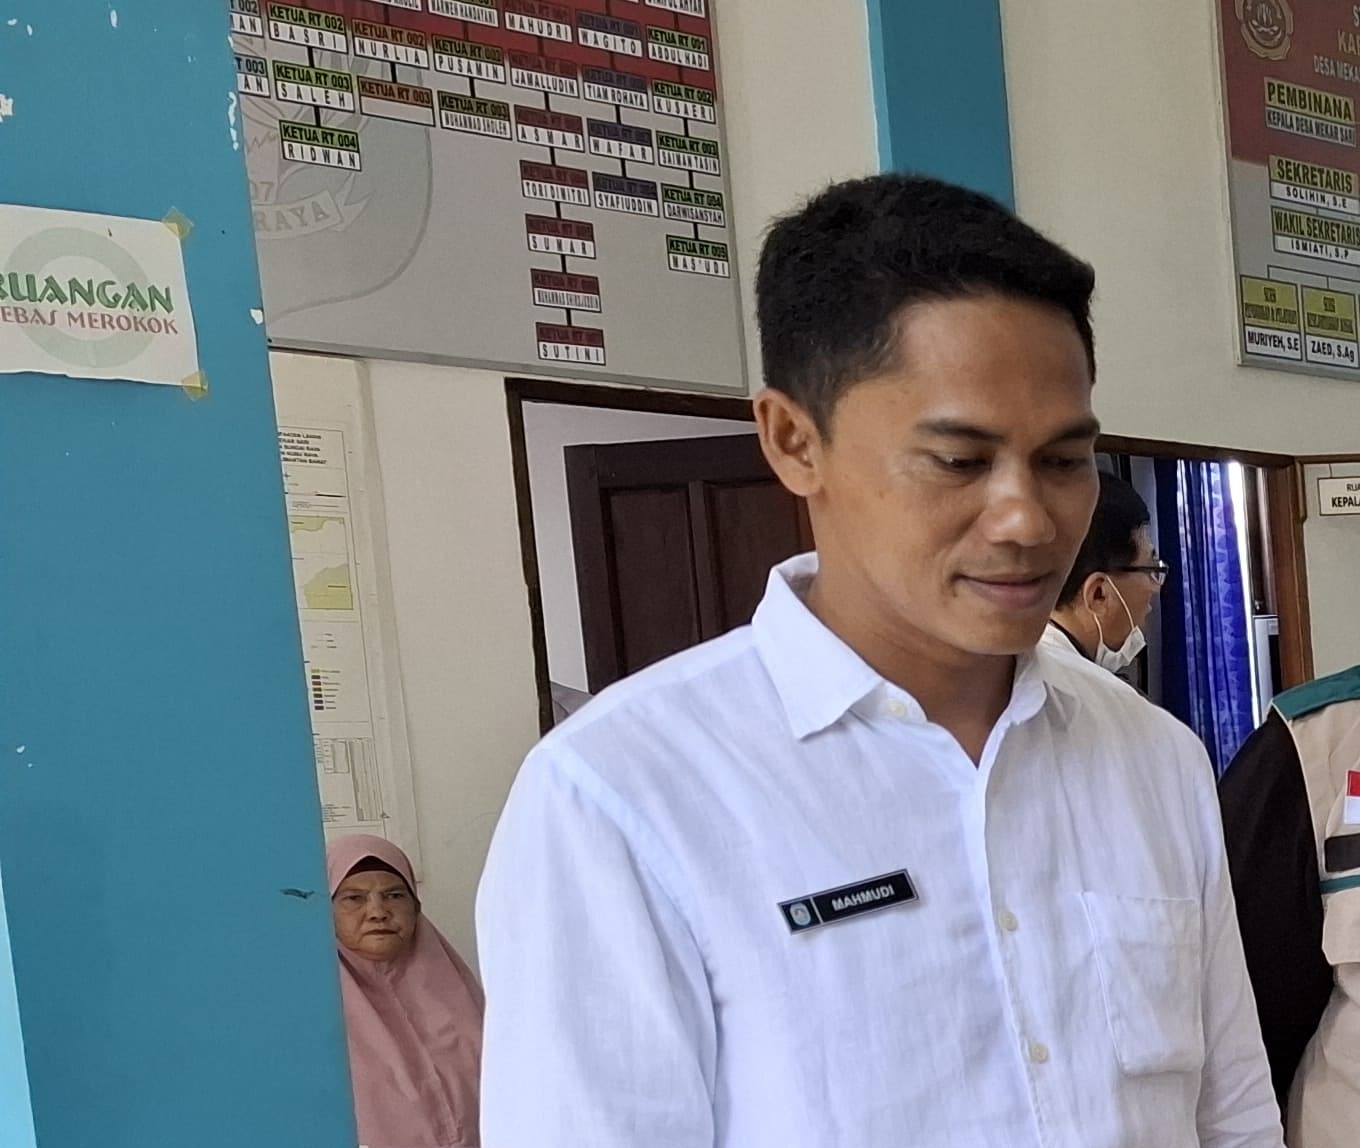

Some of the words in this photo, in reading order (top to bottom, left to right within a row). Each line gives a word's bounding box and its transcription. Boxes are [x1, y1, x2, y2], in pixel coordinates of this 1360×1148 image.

[270, 5, 306, 23] KETUA
[309, 13, 321, 26] RT
[323, 16, 343, 31] 002
[508, 13, 568, 41] MAHUDRI
[273, 23, 337, 48] BASRI
[354, 21, 389, 40] KETUA
[391, 29, 403, 41] RT
[405, 32, 424, 46] 002
[581, 30, 637, 53] WAGITO
[358, 39, 421, 65] NURLIA
[652, 45, 682, 62] ABDUL
[685, 51, 707, 68] HADI
[276, 64, 312, 83] KETUA
[315, 71, 328, 85] RT
[331, 75, 349, 90] 003
[438, 55, 499, 79] PUSAMIN
[515, 70, 575, 95] JAMALLUDIN
[281, 84, 346, 107] SALEH
[587, 84, 608, 101] TIAM
[611, 88, 646, 108] ROHAYA
[1267, 82, 1352, 121] PEMBINANA
[656, 99, 713, 121] KUSAERI
[283, 122, 319, 142] KETUA
[321, 131, 334, 144] RT
[337, 134, 356, 148] 004
[288, 143, 356, 168] RIDWAN
[593, 139, 646, 160] WAFAR
[1277, 159, 1352, 193] SEKRETARIS
[598, 190, 654, 214] SYAFIUDDIN
[667, 204, 722, 224] DARWISANSYAH
[1275, 211, 1304, 234] WAKIL
[1306, 216, 1360, 246] SEKRETARIS
[532, 235, 587, 256] SUMAR
[0, 305, 58, 327] EBAS
[67, 311, 178, 335] MEROKOK
[542, 344, 600, 361] SUTINI
[1311, 340, 1335, 358] ZAED,
[1337, 344, 1355, 363] S.Ag
[831, 884, 895, 911] MAHMUDI
